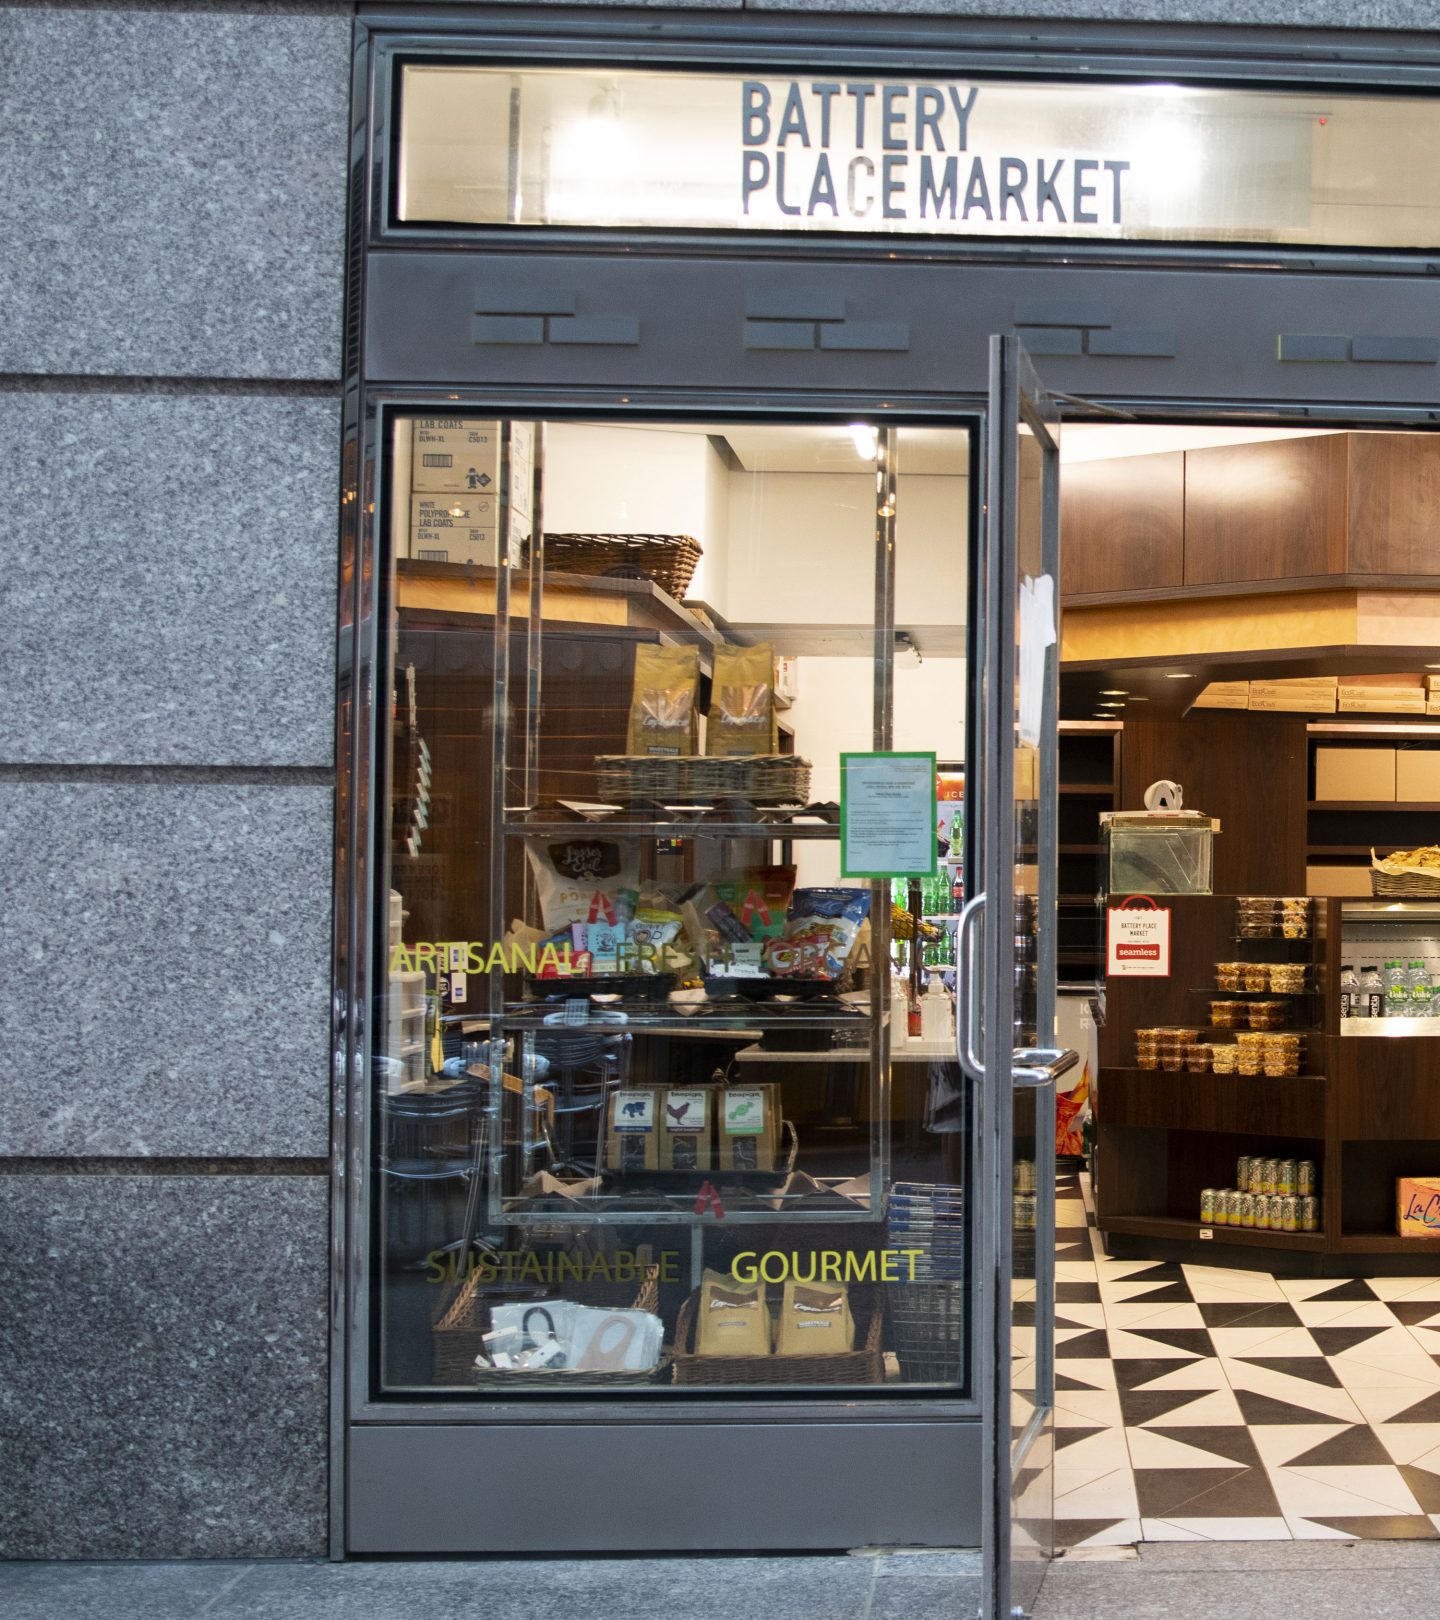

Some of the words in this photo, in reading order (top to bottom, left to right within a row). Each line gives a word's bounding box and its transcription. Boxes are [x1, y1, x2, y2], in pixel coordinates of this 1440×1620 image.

[742, 81, 979, 151] BATTERY
[420, 519, 431, 527] LAB
[433, 519, 453, 527] COATS
[389, 941, 586, 975] ARTISANAL
[615, 941, 730, 974] FRESH
[1119, 948, 1157, 956] seamless
[426, 1250, 680, 1284] SUSTAINABLE
[731, 1250, 924, 1284] GOURMET
